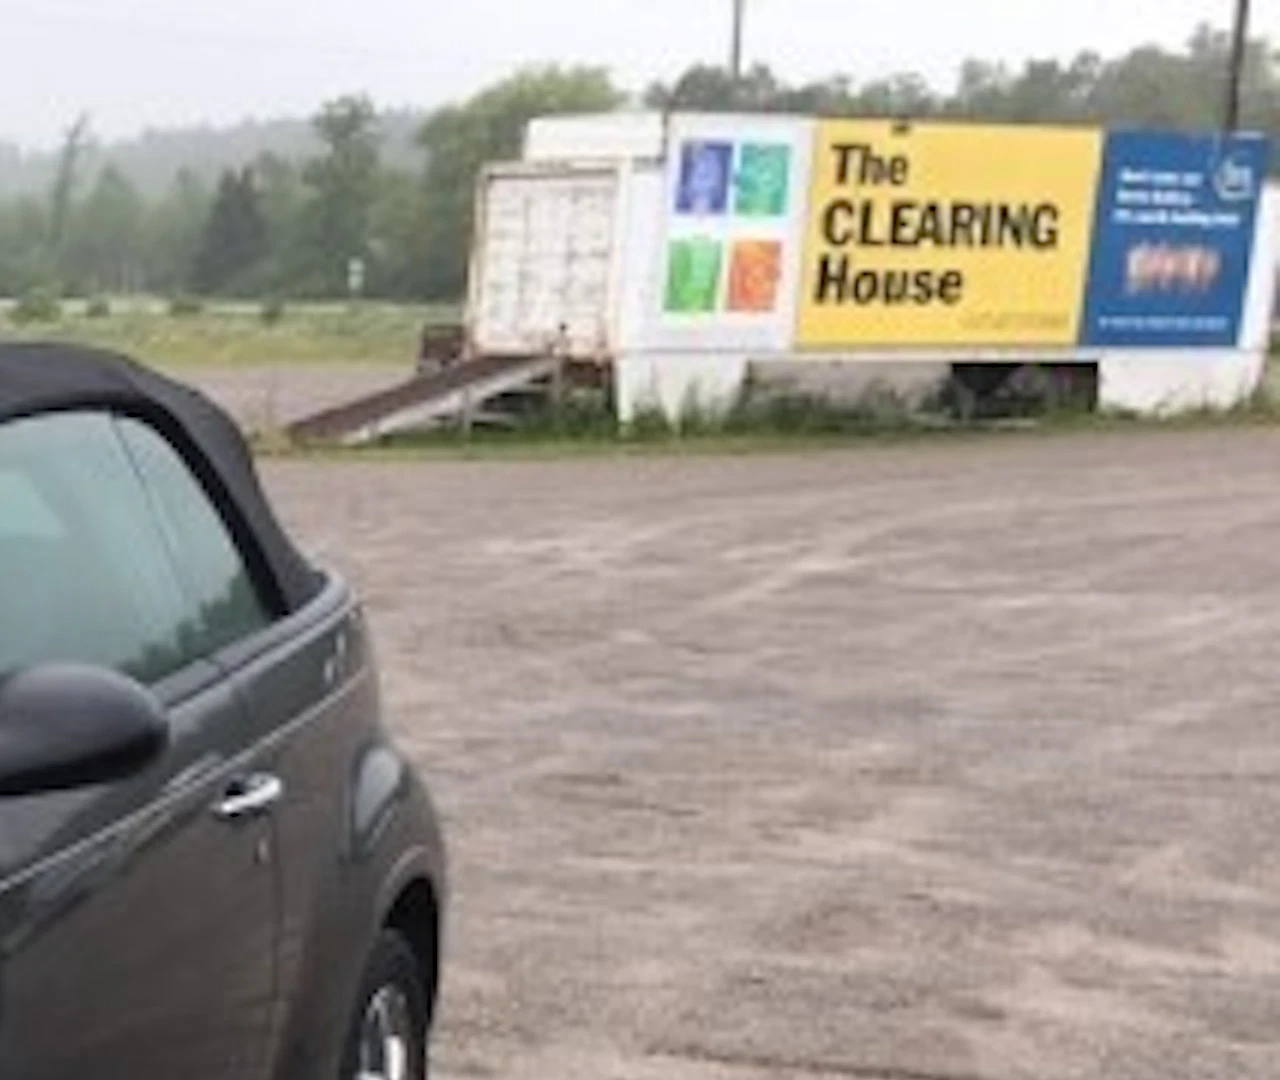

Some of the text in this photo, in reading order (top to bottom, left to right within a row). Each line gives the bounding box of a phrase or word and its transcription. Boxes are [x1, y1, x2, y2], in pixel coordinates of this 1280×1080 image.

[831, 143, 909, 186] The
[822, 198, 1060, 249] CLEARING
[814, 253, 964, 306] House
